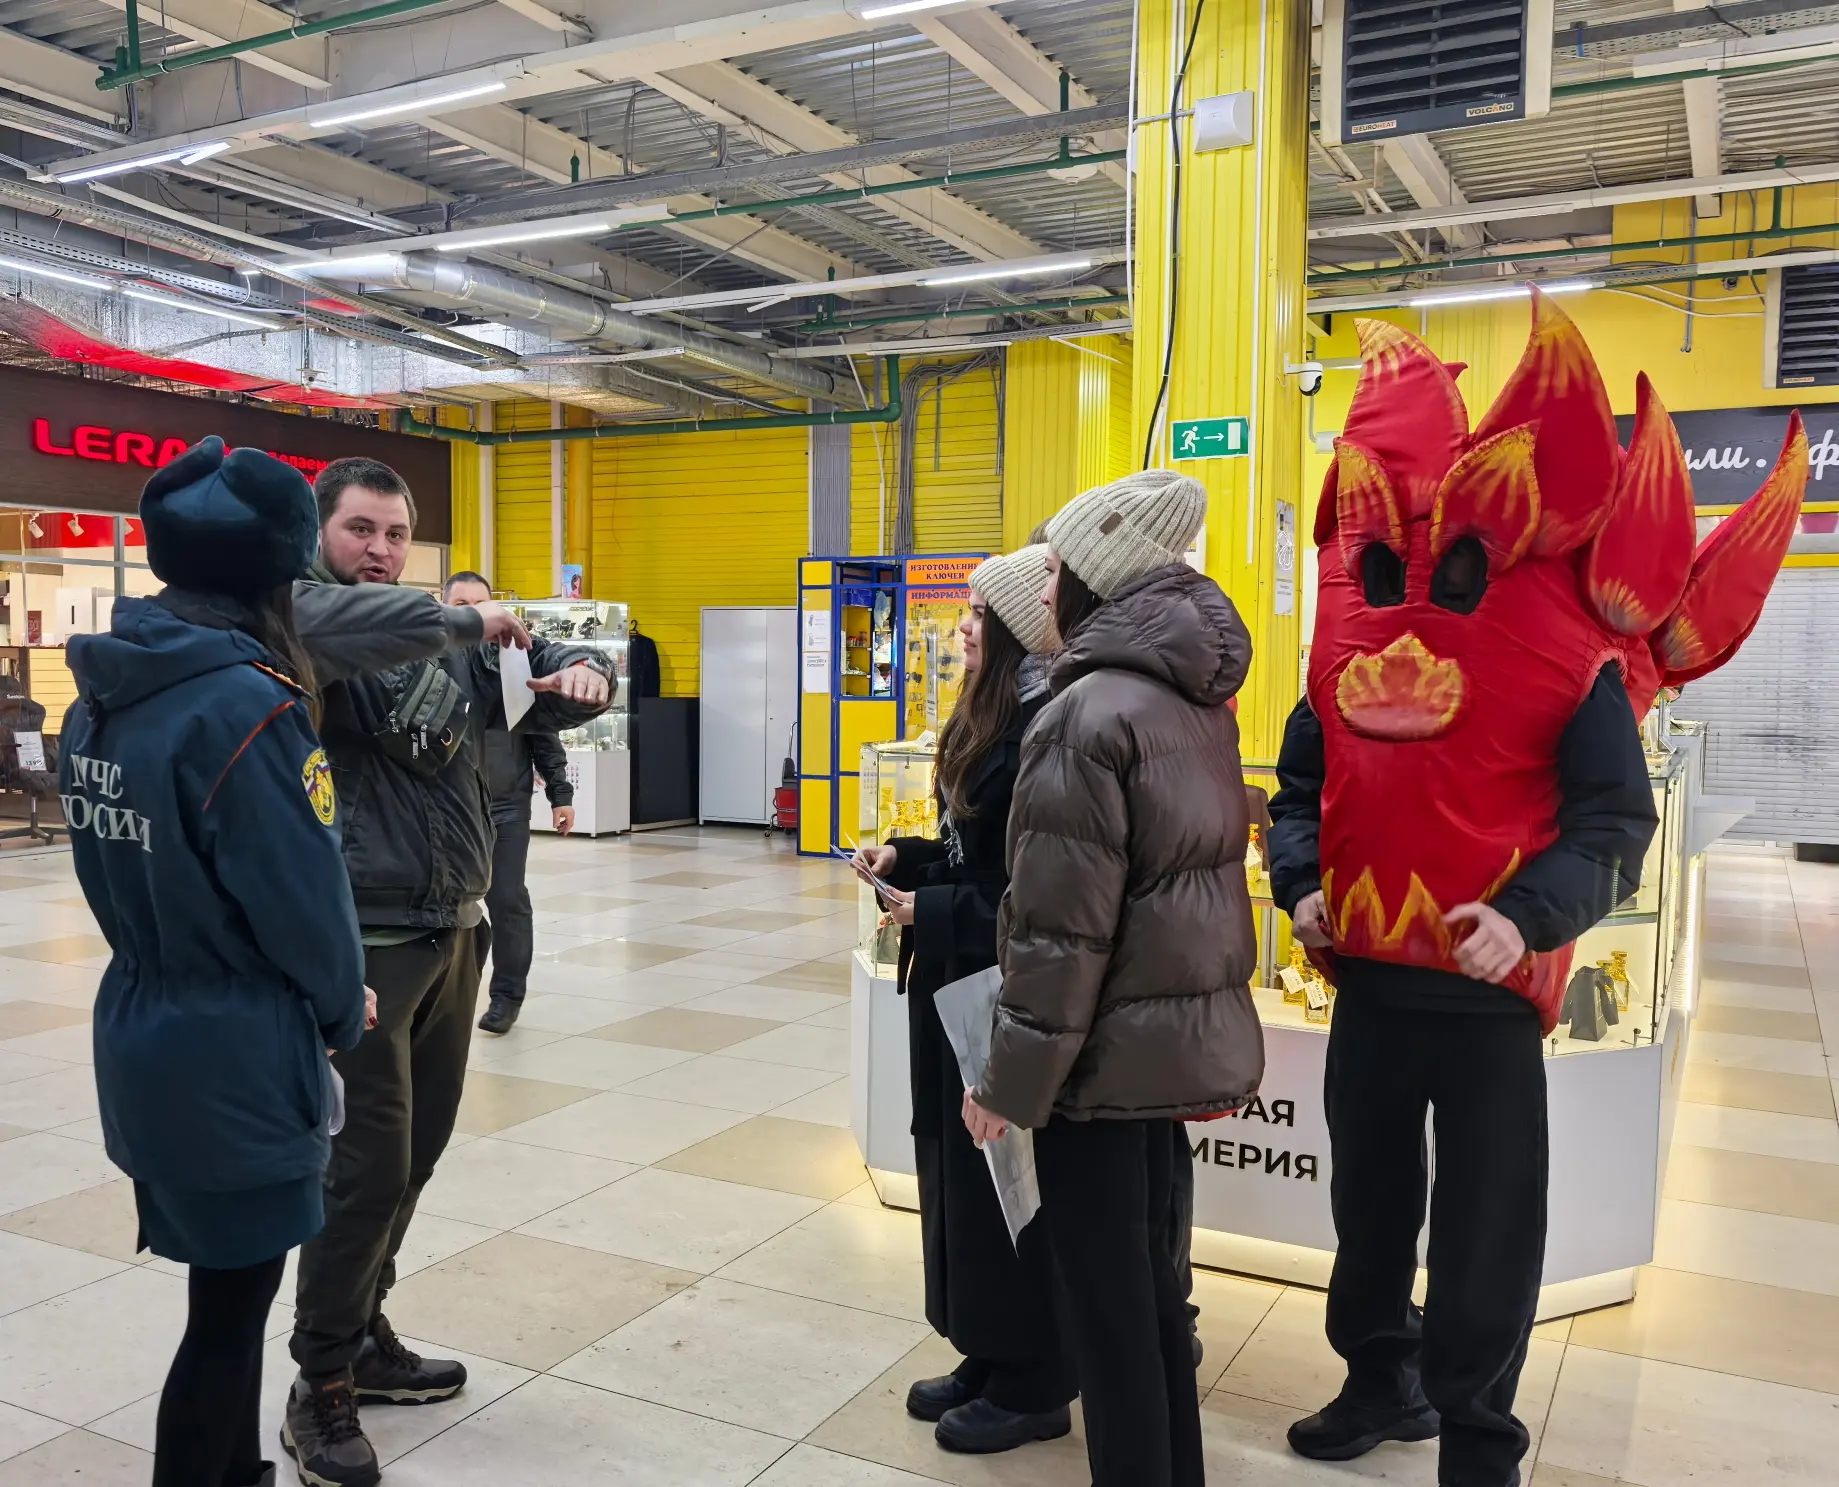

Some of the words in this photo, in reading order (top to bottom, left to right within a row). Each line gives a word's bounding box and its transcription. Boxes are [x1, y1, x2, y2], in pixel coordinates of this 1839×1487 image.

[1468, 102, 1514, 116] VOLCANO
[1353, 121, 1395, 132] EUROHEAT
[1231, 1096, 1295, 1128] АЯ
